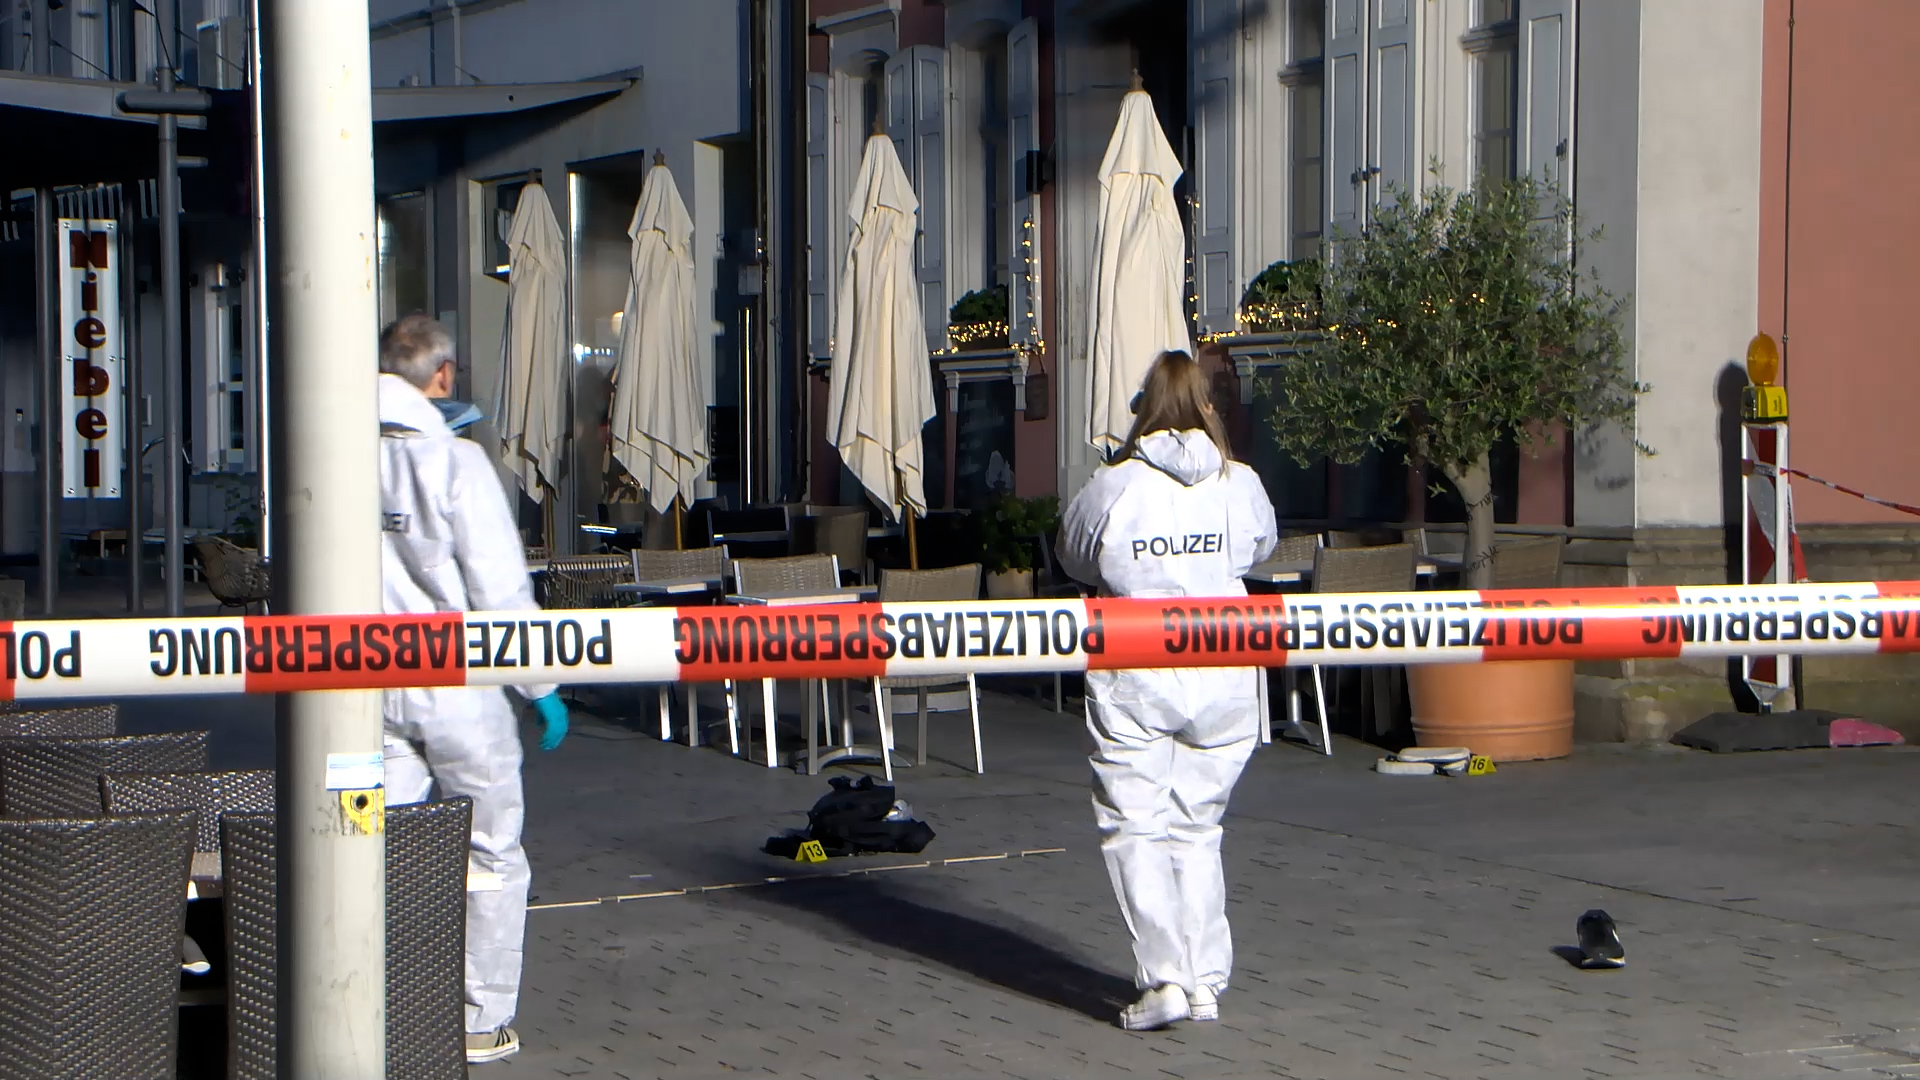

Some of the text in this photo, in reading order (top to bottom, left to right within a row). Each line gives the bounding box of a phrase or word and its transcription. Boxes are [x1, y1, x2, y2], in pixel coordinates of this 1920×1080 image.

[69, 230, 110, 488] Niebel
[1132, 533, 1223, 560] POLIZEI
[0, 629, 82, 679] POL
[149, 619, 612, 677] POLIZEIABSPERRUNG
[673, 609, 1105, 664] POLIZEIABSPERRUNG
[1472, 758, 1486, 771] 16
[806, 844, 823, 858] 13
